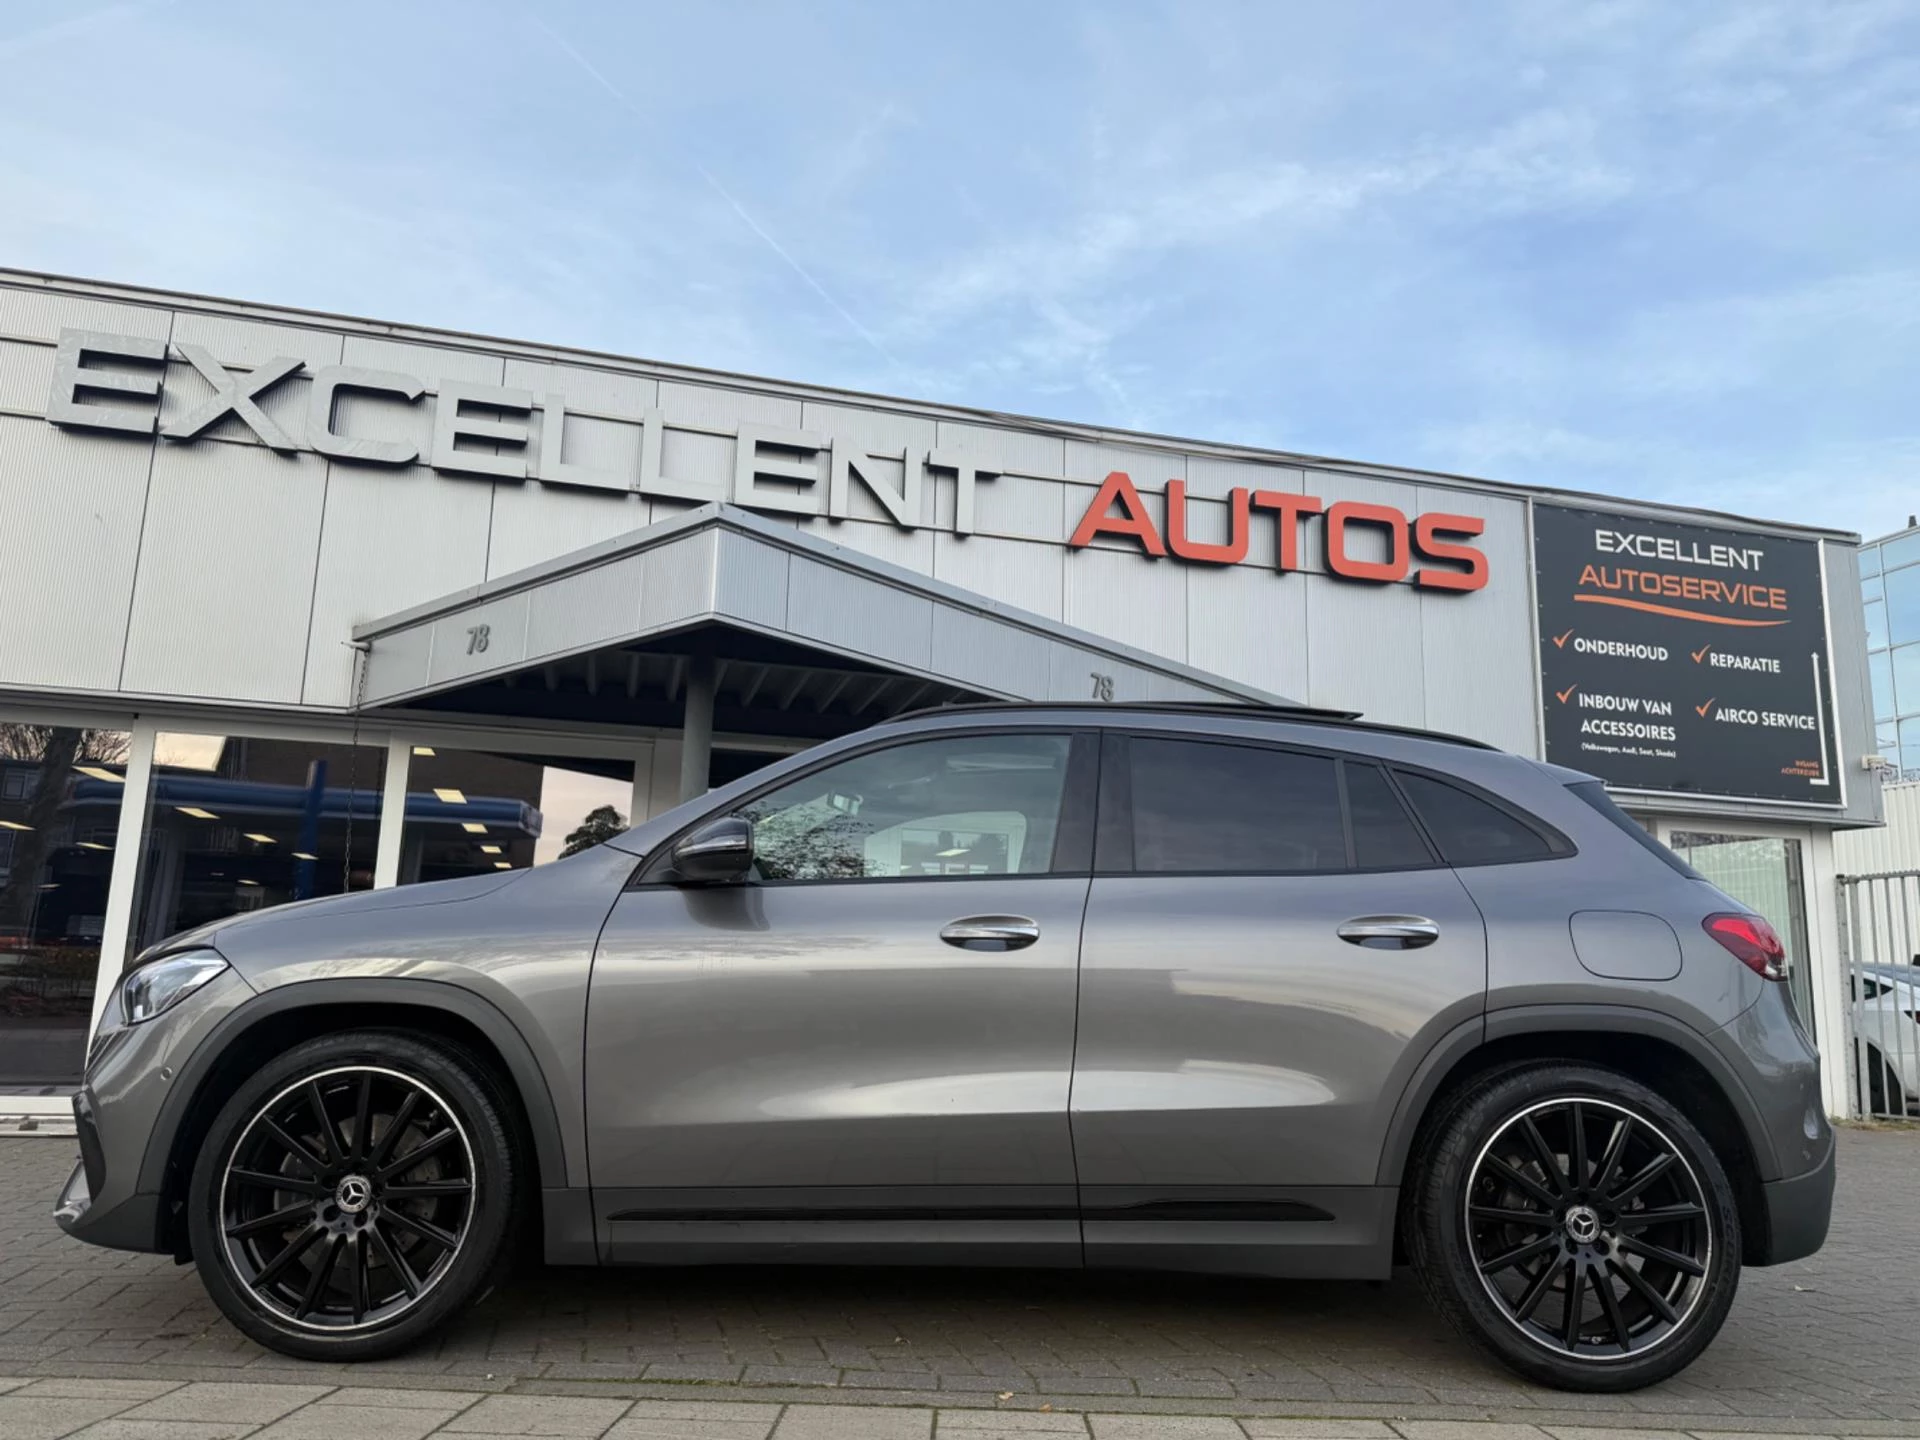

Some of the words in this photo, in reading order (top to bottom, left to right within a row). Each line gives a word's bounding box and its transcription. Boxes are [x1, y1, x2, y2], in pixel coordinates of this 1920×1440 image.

[46, 328, 1004, 536] EXCELLENT
[1069, 471, 1490, 592] AUTOS
[1595, 529, 1764, 571] EXCELLENT
[1578, 564, 1788, 611] AUTOSERVICE
[466, 624, 491, 656] 78
[1574, 637, 1669, 661] ONDERHOUD
[1709, 652, 1781, 673] REPARATIE
[1090, 672, 1114, 703] 78
[1578, 693, 1639, 713] INBOUW
[1642, 700, 1672, 716] VAN
[1580, 719, 1677, 742] ACCESSOIRES
[1715, 708, 1758, 726] AIRCO
[1761, 712, 1817, 731] SERVICE
